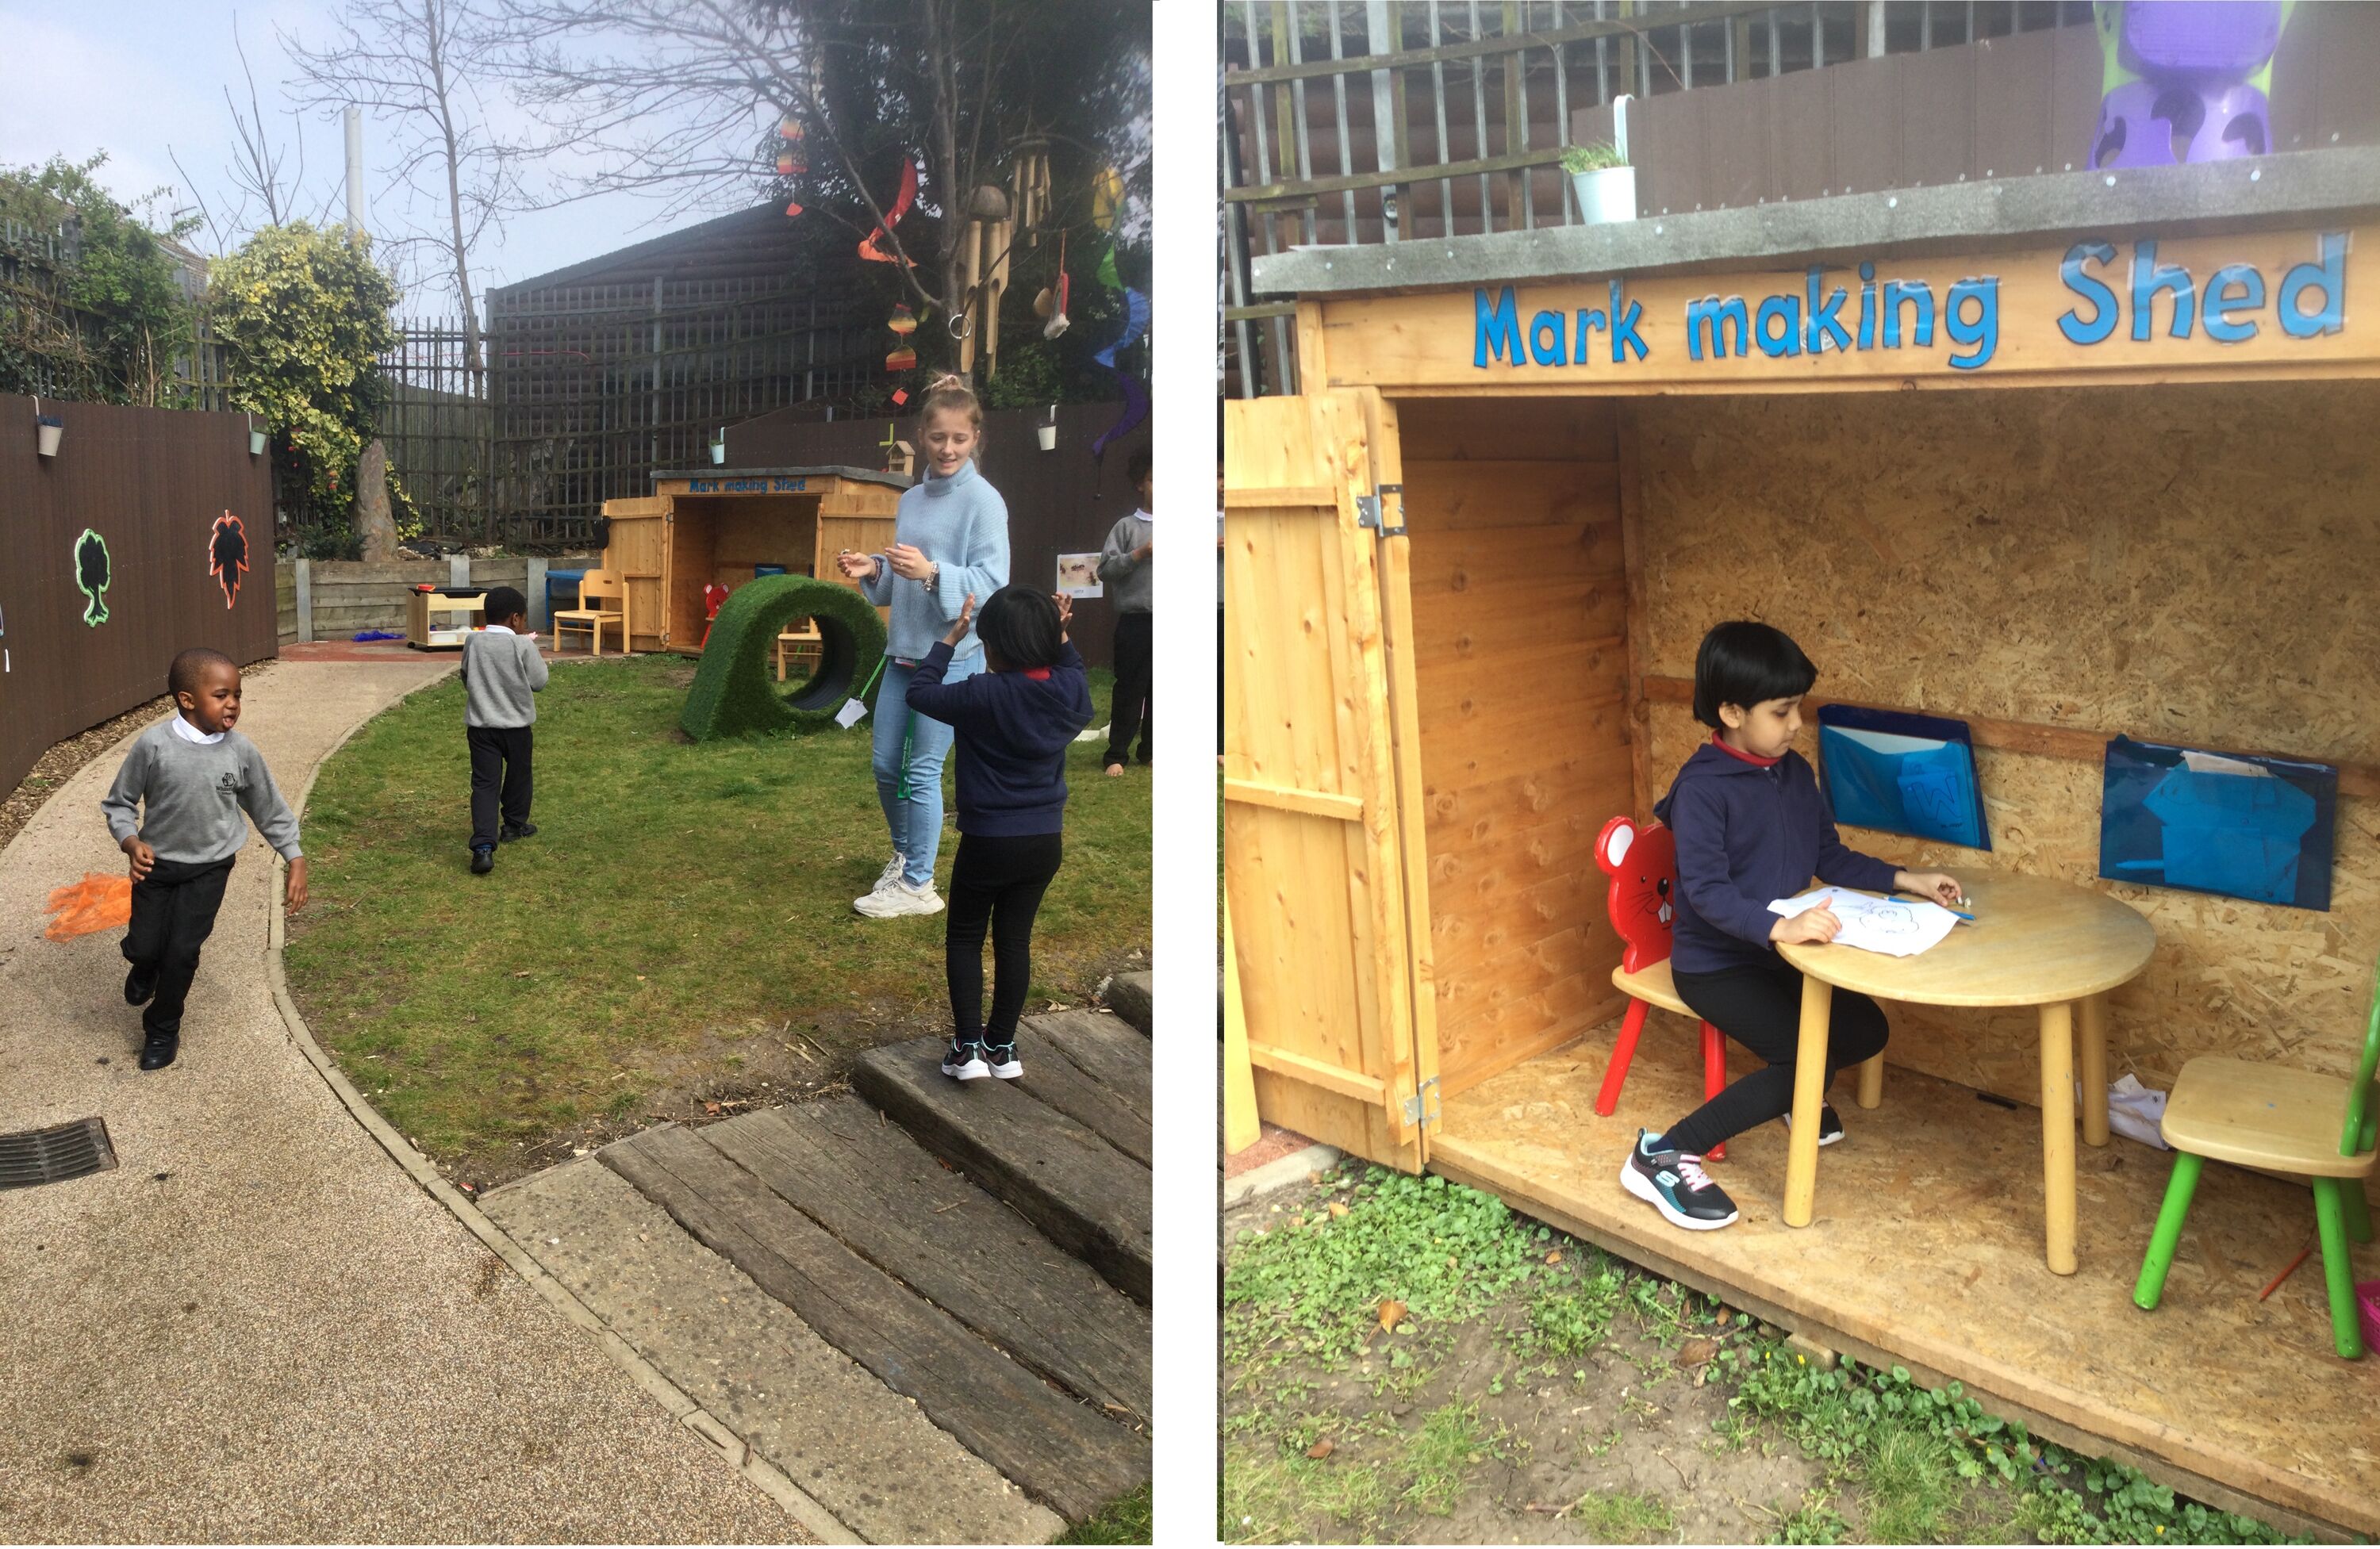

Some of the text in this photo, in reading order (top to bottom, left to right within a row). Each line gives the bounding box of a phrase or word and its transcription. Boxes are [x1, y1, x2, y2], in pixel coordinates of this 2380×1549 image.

[1473, 232, 2348, 370] Mark making Shed
[689, 476, 806, 494] Mark making Shed
